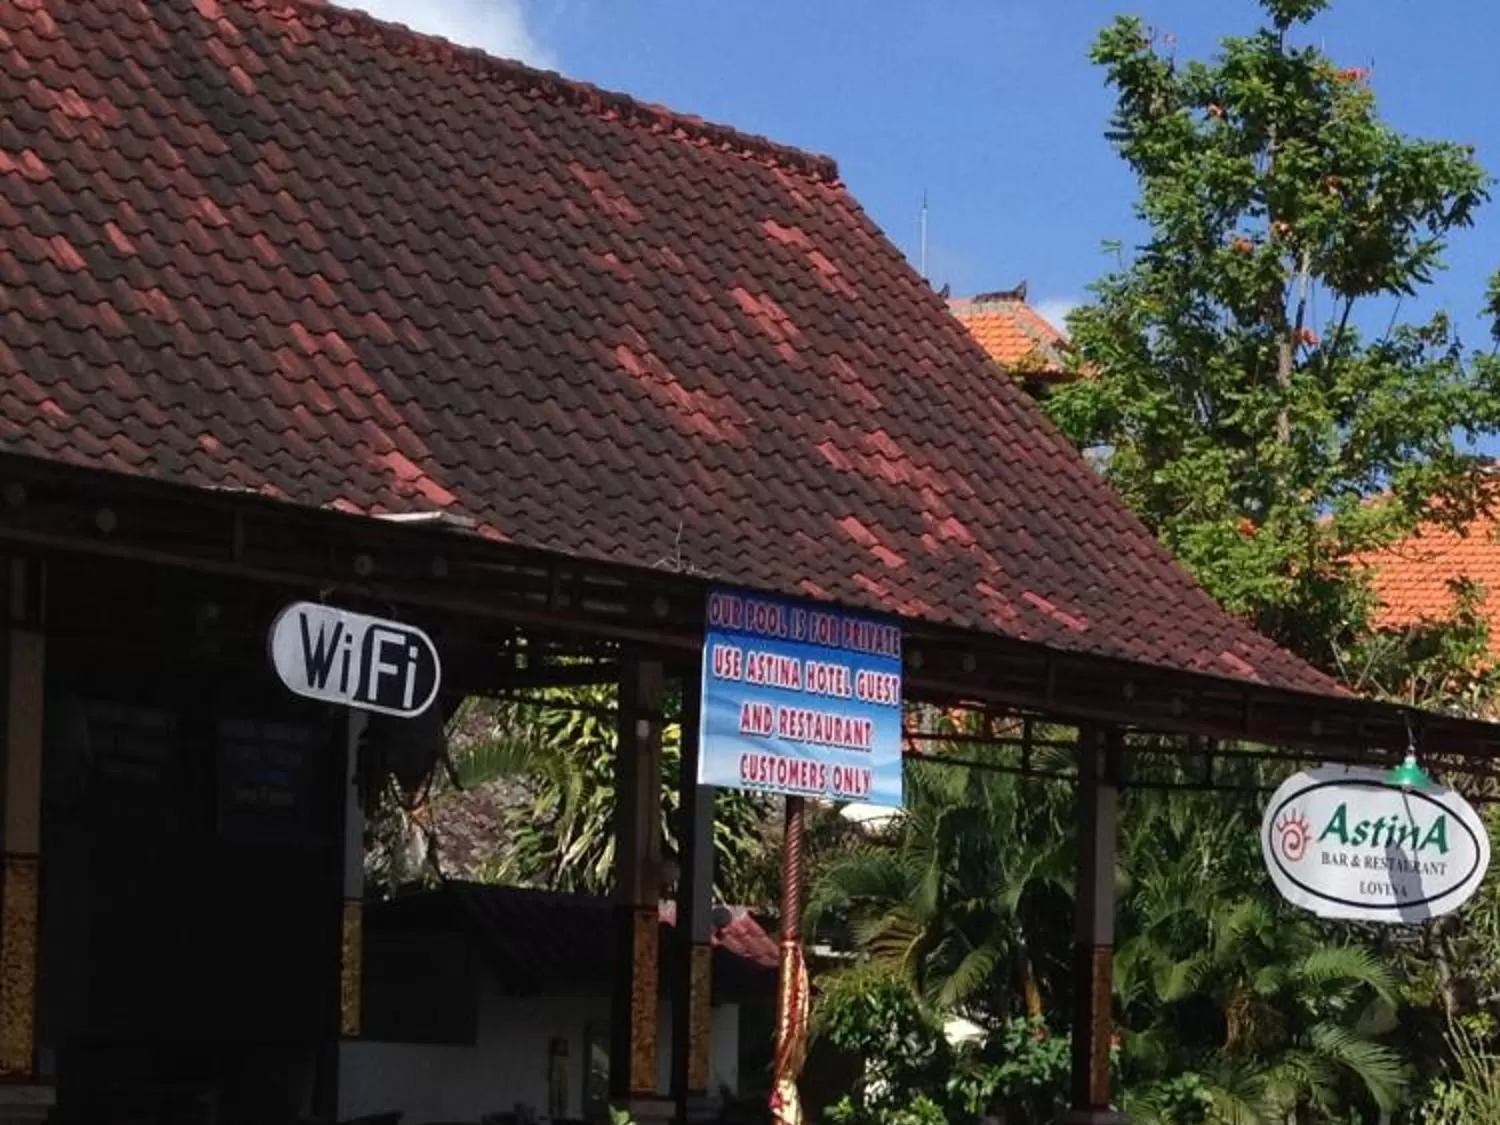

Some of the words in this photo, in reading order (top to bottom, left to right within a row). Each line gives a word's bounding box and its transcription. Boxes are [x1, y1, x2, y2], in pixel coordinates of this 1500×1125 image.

[745, 600, 788, 638] POOL
[299, 612, 419, 709] WiFi
[712, 645, 743, 679] USE
[747, 651, 801, 692] ASTINA
[806, 660, 853, 700] HOTEL
[856, 668, 900, 706] GUEST
[740, 701, 774, 735] AND
[778, 706, 873, 750] RESTAURANT
[740, 752, 827, 793] CUSTOMERS
[832, 765, 873, 797] ONLY
[1321, 851, 1348, 867] BAR
[1350, 857, 1361, 868] &
[1363, 855, 1448, 876] RESTAURANT
[1359, 880, 1408, 898] LOVINA
